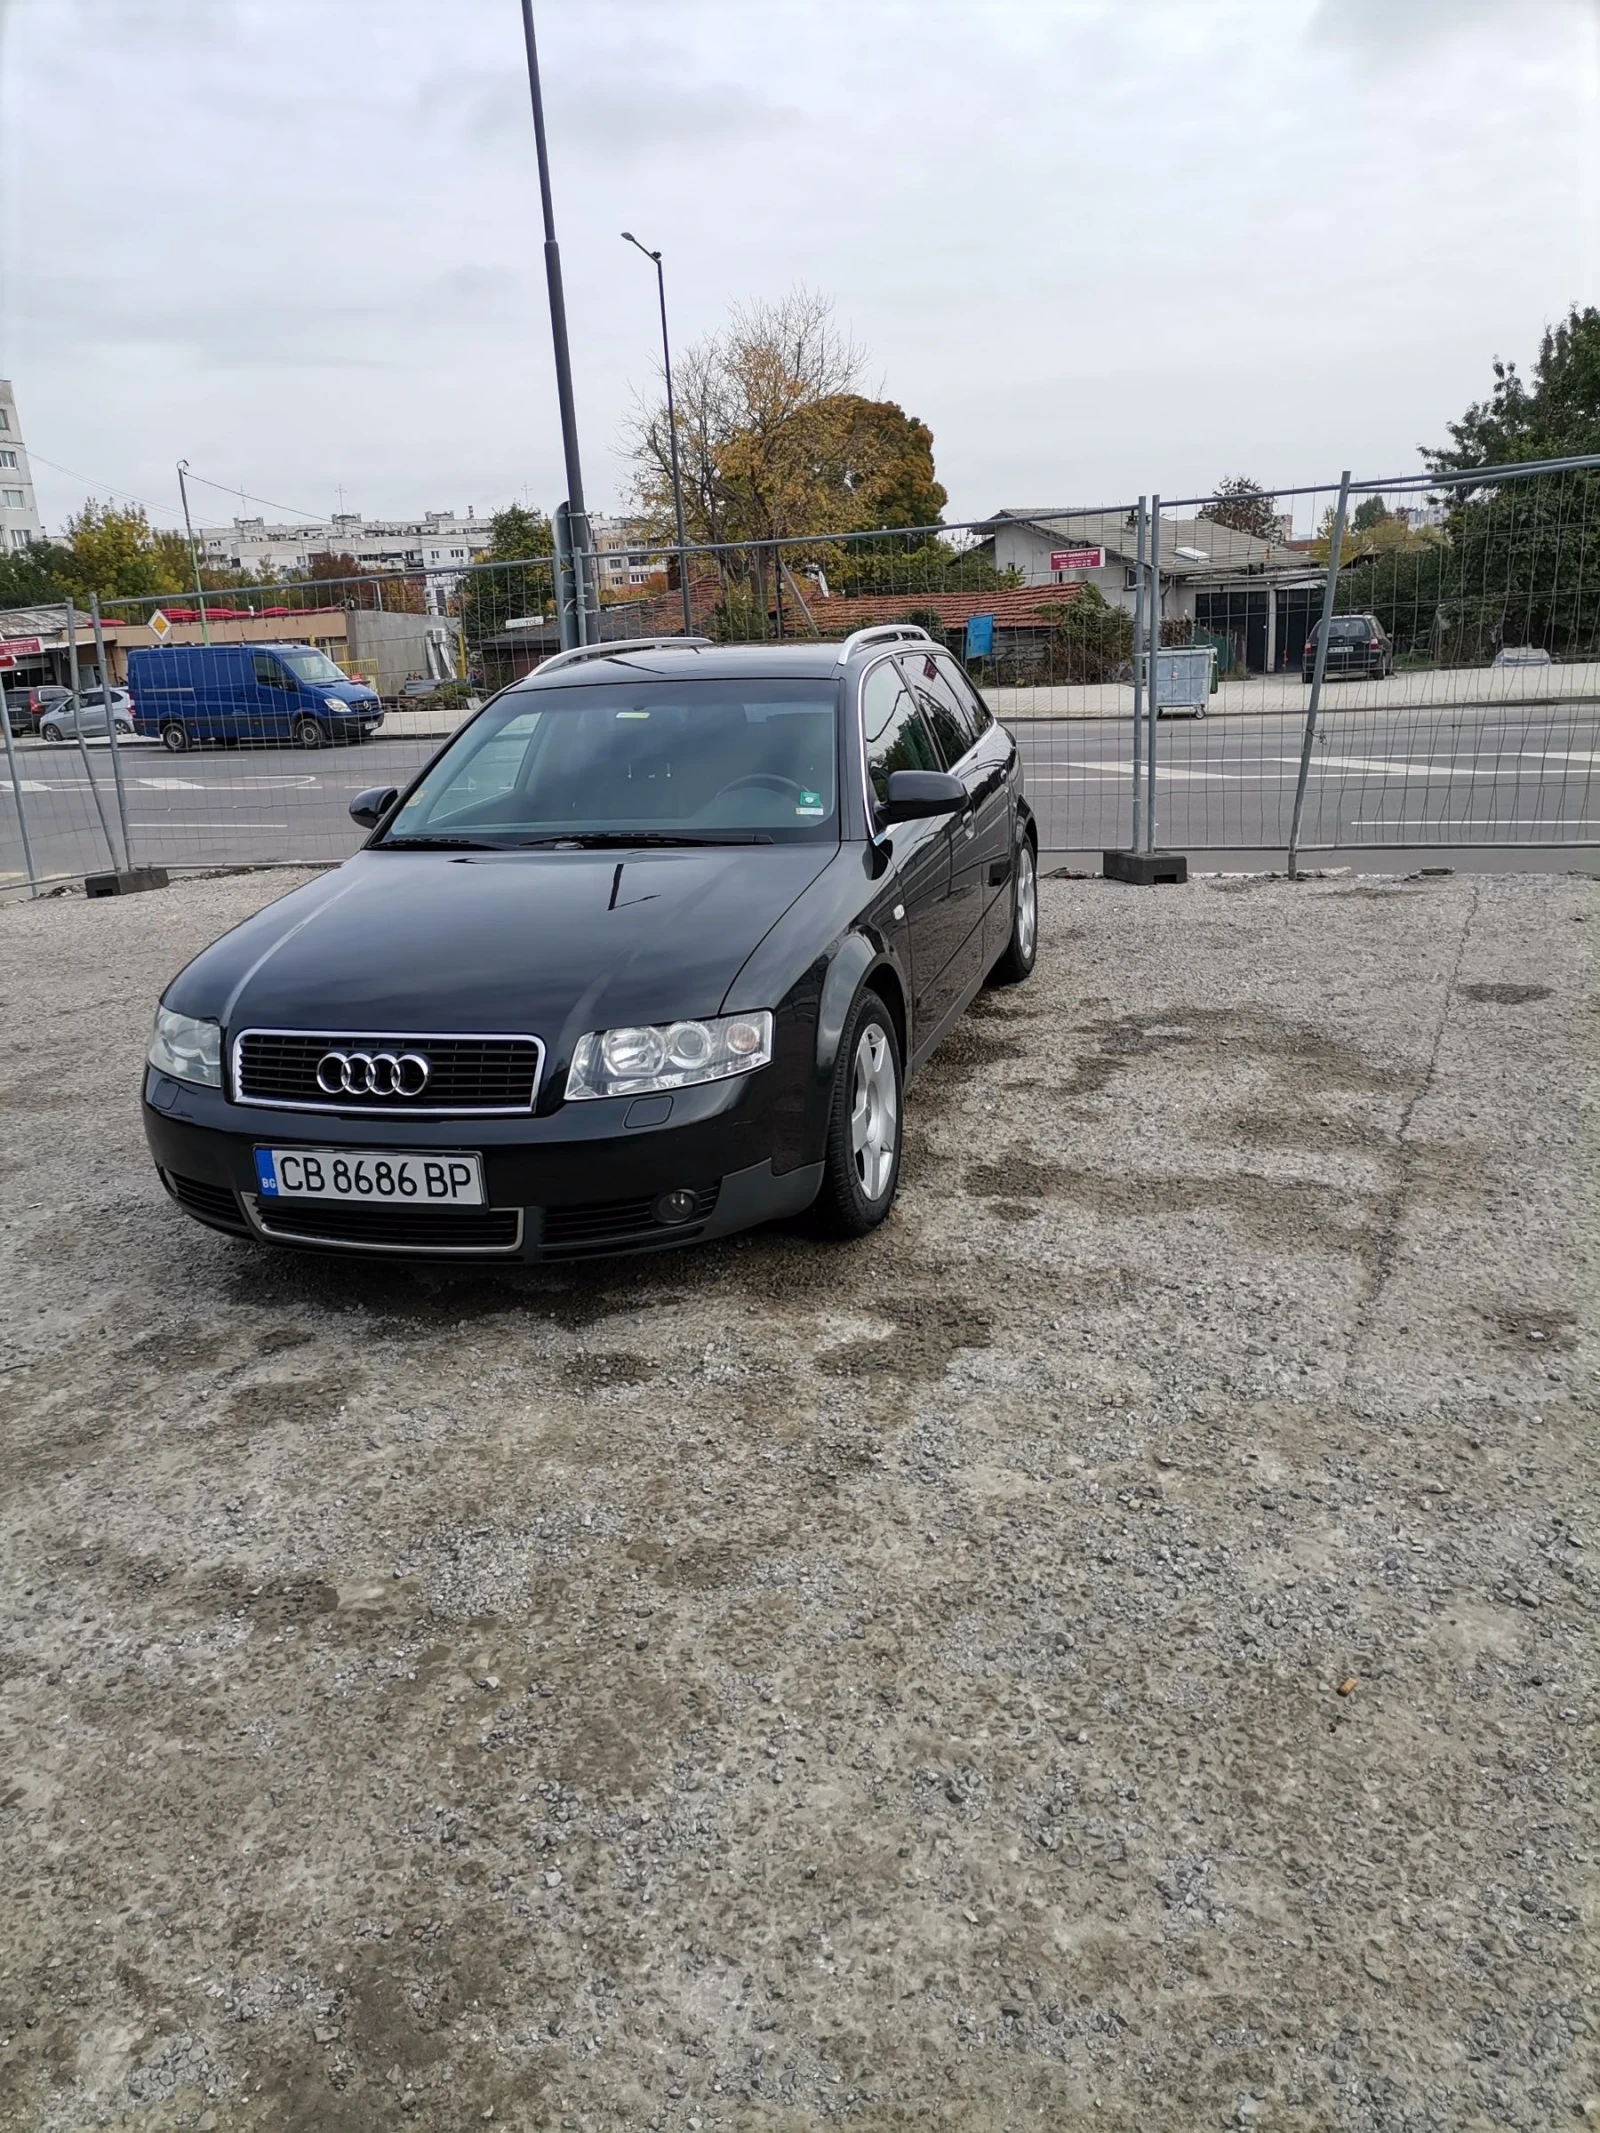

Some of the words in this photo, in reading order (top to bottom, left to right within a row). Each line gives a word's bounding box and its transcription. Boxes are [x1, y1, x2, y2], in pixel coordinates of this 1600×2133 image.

[261, 1176, 276, 1189] BG
[280, 1156, 325, 1192] CB
[333, 1159, 418, 1197] 8686
[424, 1162, 471, 1198] BP
